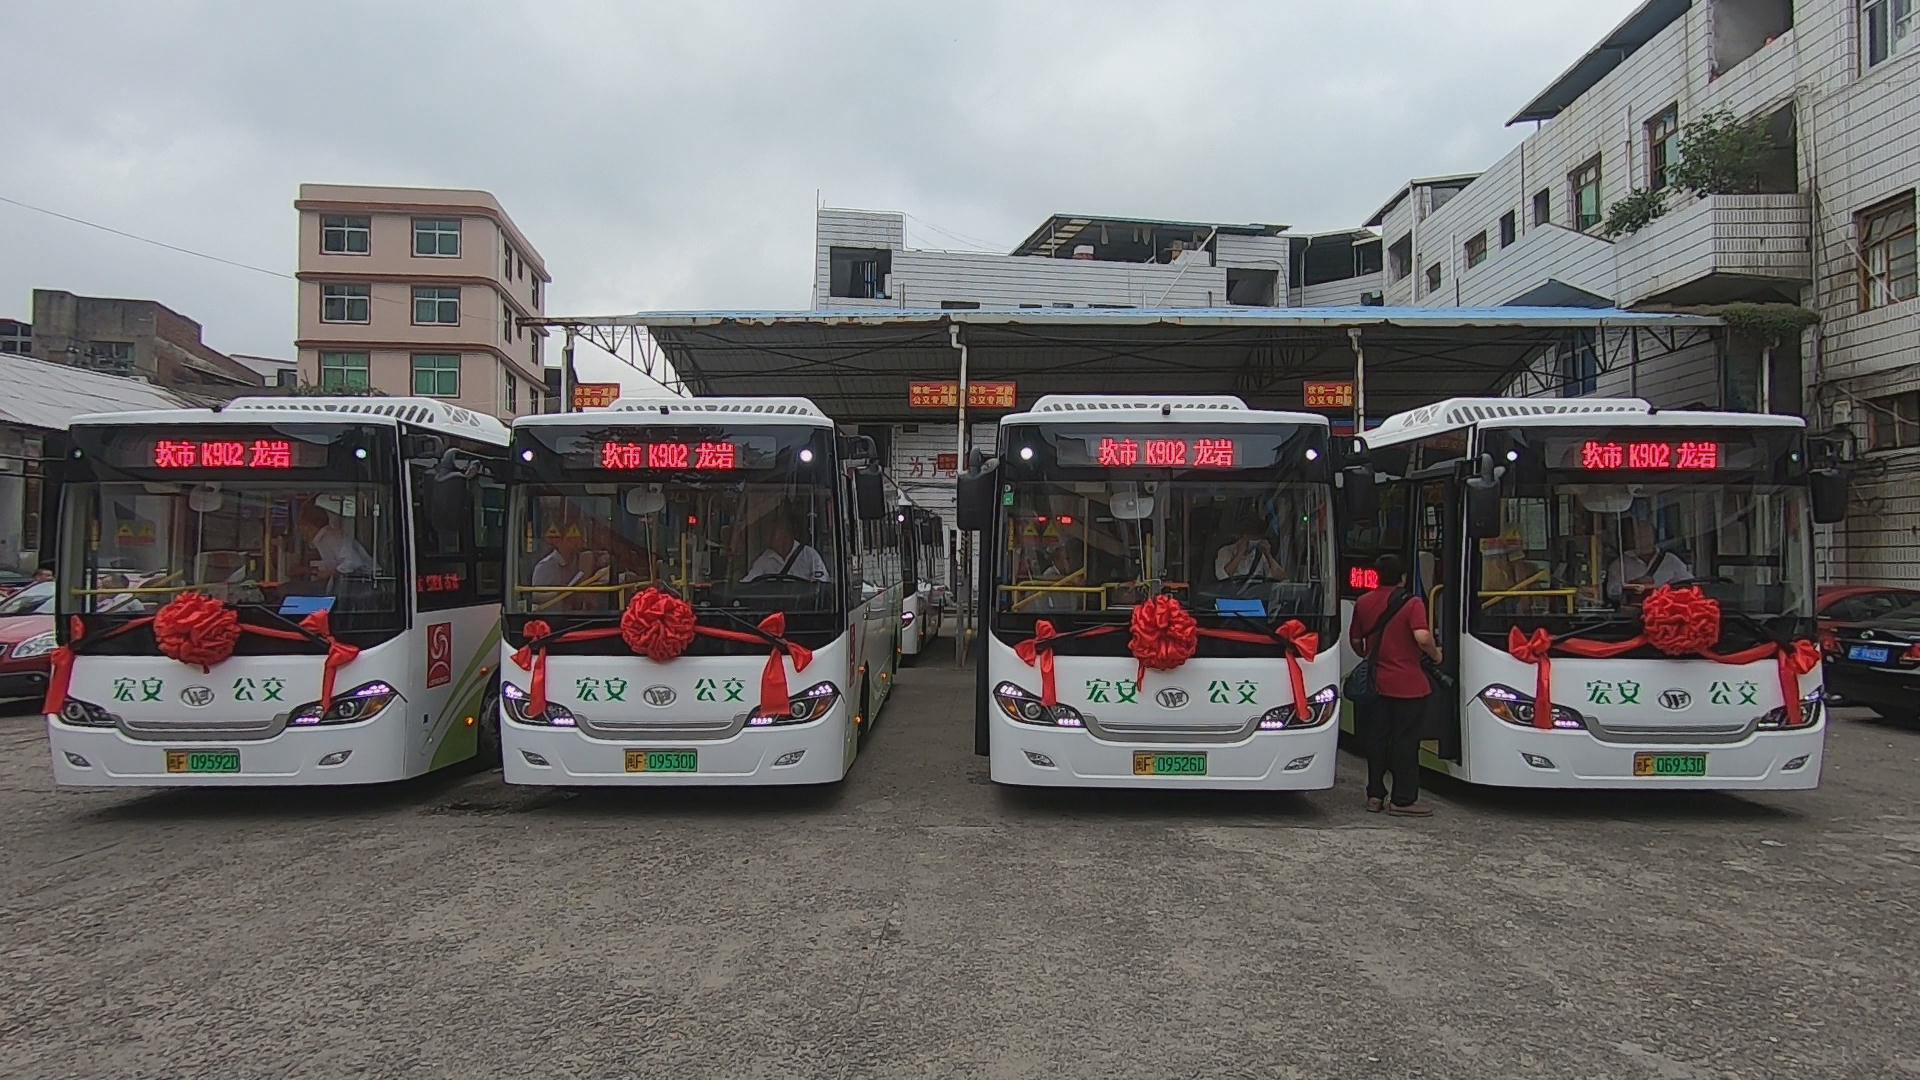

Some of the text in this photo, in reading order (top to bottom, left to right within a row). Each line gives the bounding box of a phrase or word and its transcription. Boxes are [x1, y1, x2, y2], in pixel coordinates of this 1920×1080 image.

[156, 441, 291, 468] 坎市 K902 龙岩
[602, 442, 736, 469] 坎市 K902 龙岩
[1099, 439, 1233, 466] 坎市 K902 龙岩
[1582, 442, 1717, 469] 坎市 K902 龙岩
[113, 678, 287, 703] 宏安 公交
[575, 679, 746, 704] 宏安 公交
[1085, 680, 1259, 705] 宏安 公交
[1586, 680, 1760, 706] 宏安 公交
